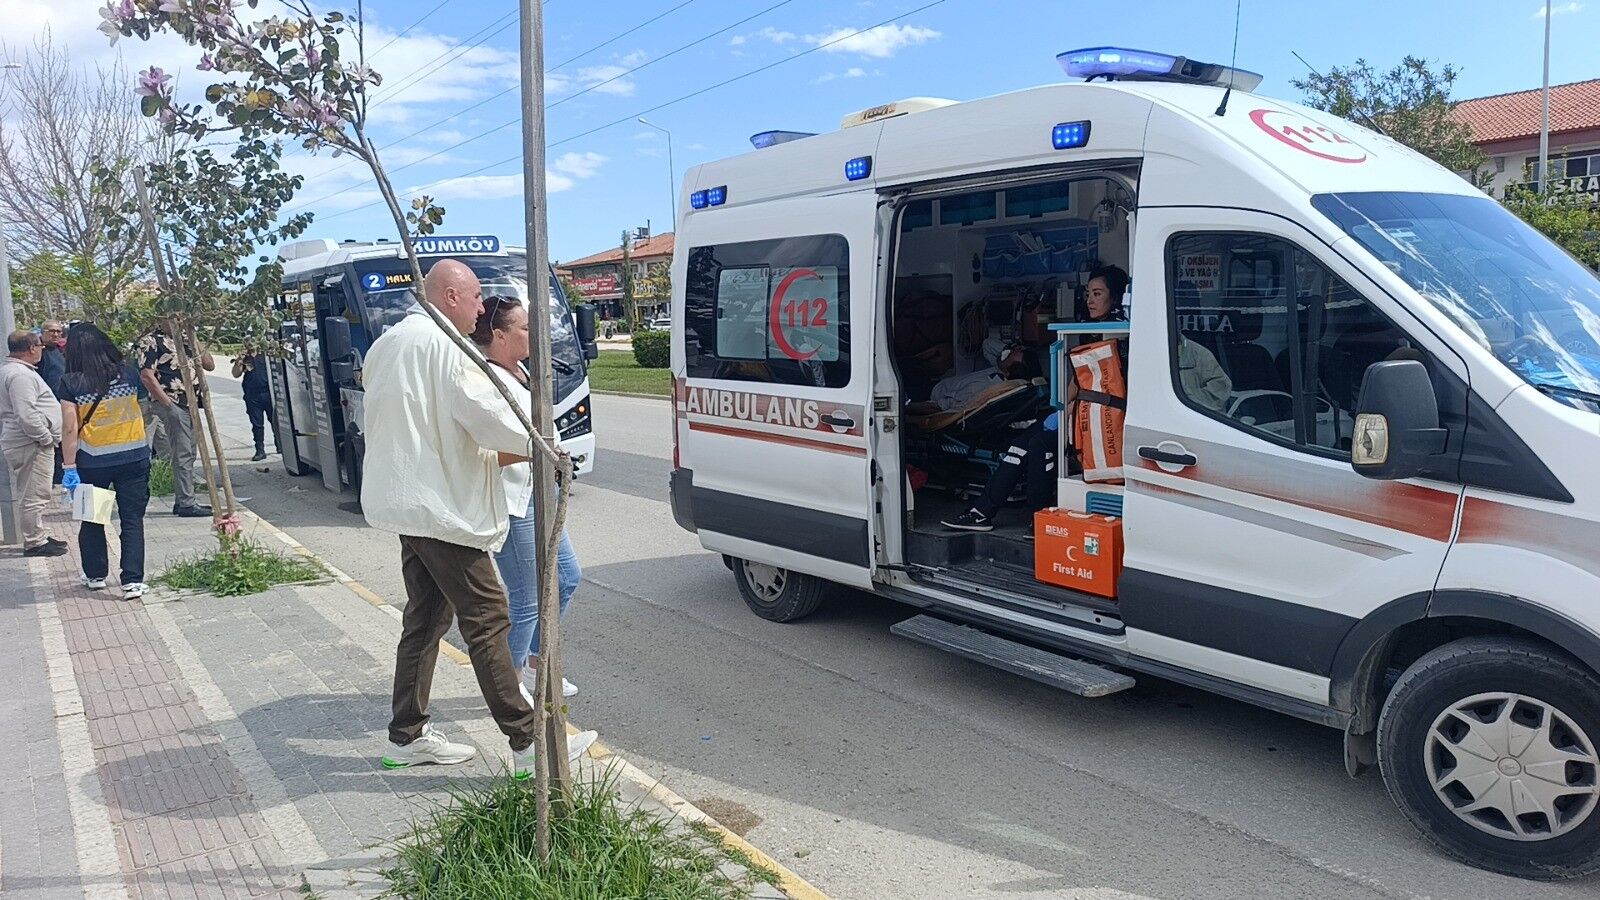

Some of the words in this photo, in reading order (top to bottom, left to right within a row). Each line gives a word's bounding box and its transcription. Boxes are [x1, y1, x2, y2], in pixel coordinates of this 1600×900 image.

[1282, 125, 1352, 144] 112
[411, 237, 494, 253] KUMKÖY
[368, 274, 381, 289] 2
[385, 274, 412, 285] HALK
[783, 297, 829, 328] 112
[687, 388, 819, 429] AMBULANS
[1053, 562, 1075, 576] First
[1077, 567, 1093, 580] Aid
